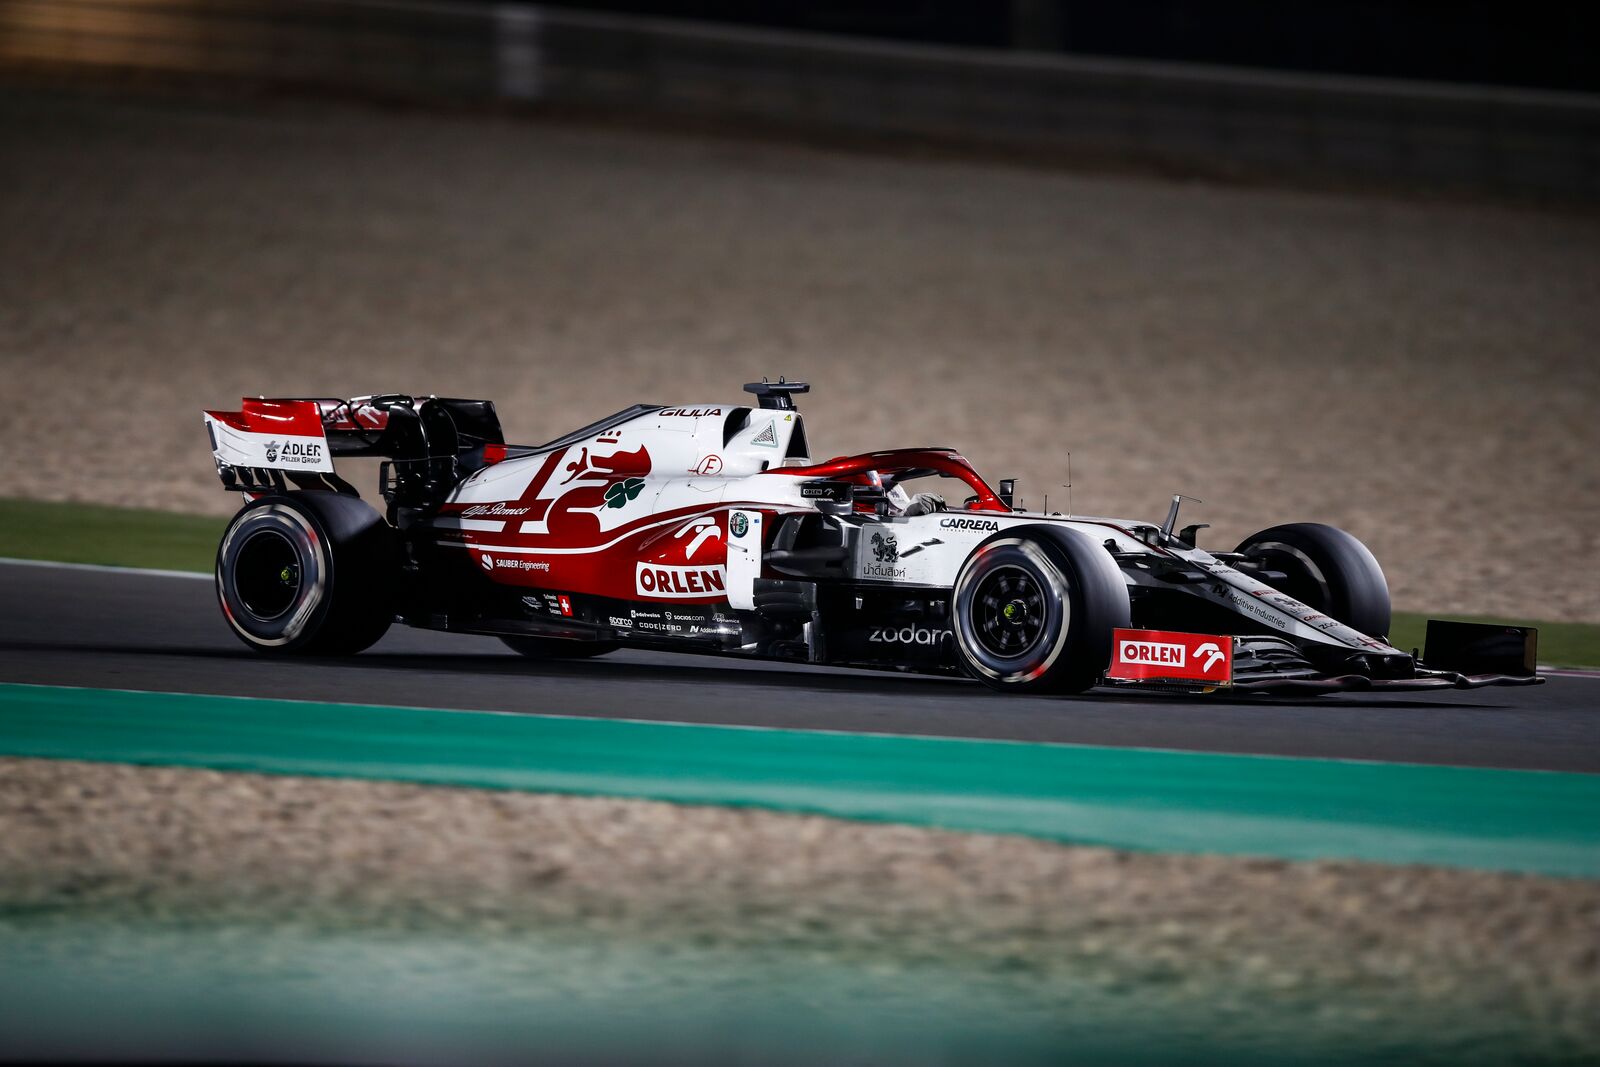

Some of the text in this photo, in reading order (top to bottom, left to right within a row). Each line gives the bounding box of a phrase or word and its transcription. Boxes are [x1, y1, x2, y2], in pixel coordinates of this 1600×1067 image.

[658, 408, 722, 417] GIULIA
[281, 440, 322, 457] ADLER
[487, 502, 531, 516] Romeo
[940, 518, 999, 532] CARRERA
[495, 559, 550, 572] SAUBER Engineering
[639, 567, 725, 594] ORLEN
[1228, 592, 1254, 612] Additive
[1253, 606, 1287, 629] Industries
[1124, 643, 1182, 664] ORLEN
